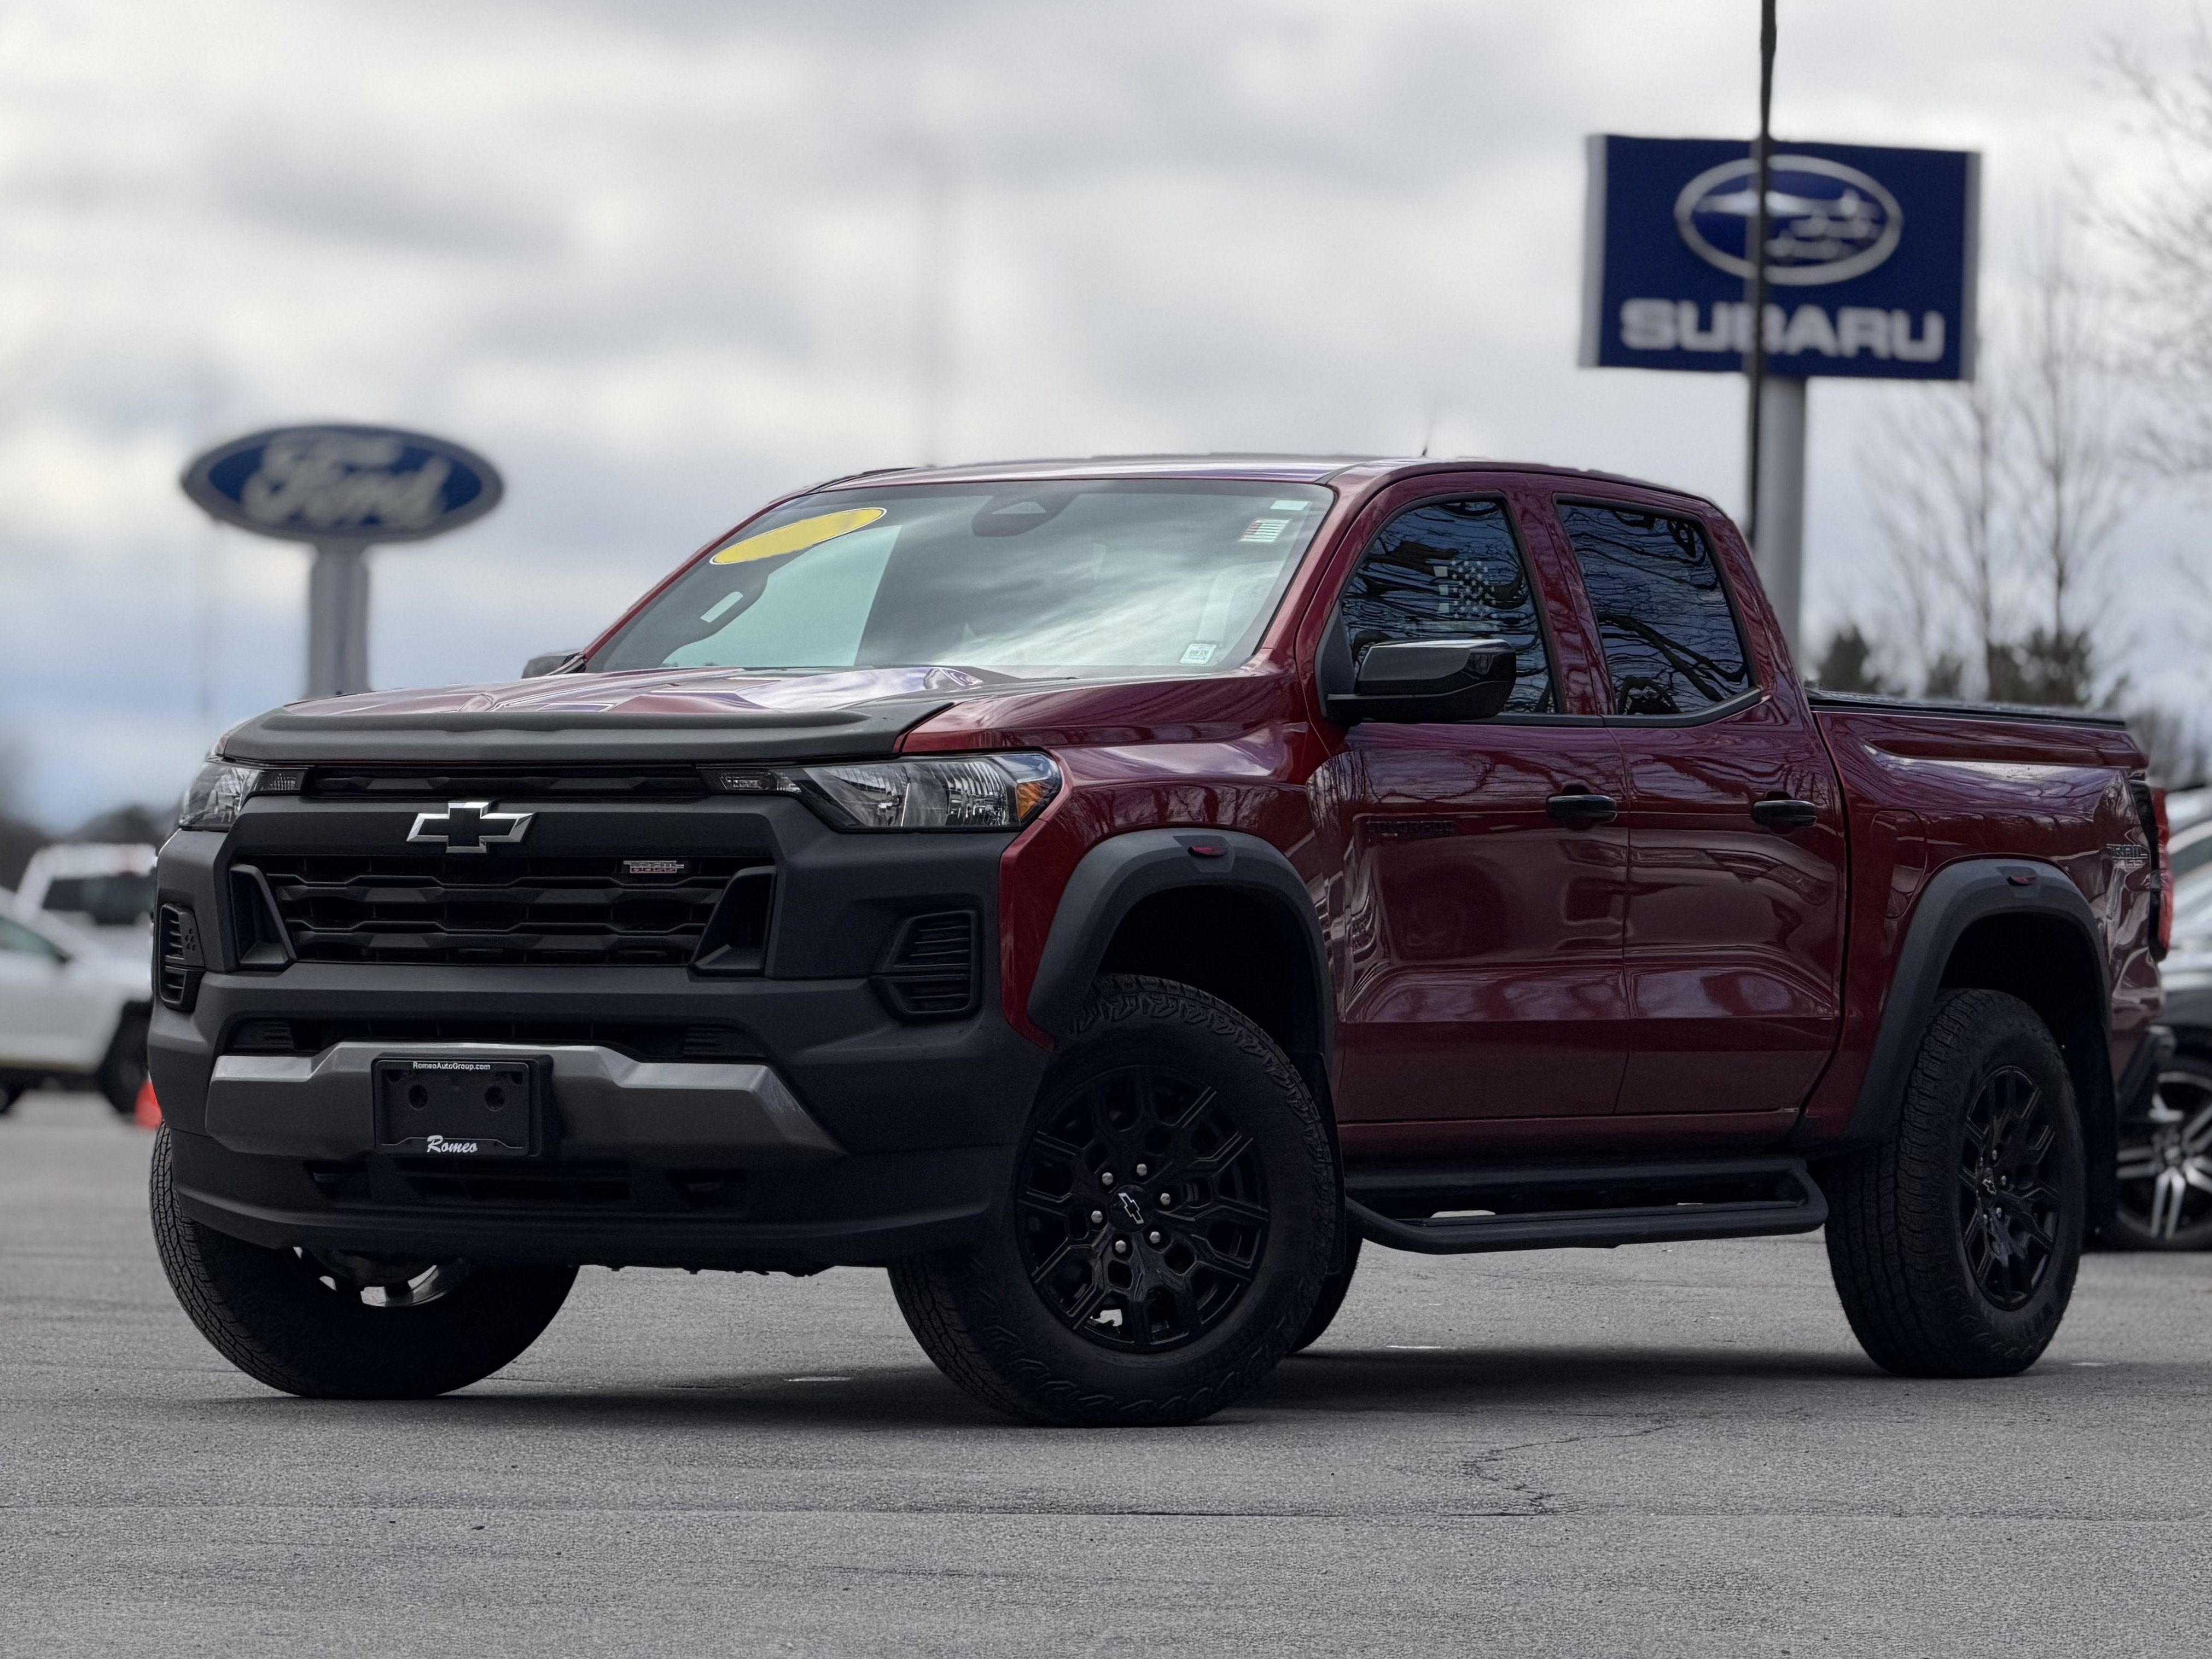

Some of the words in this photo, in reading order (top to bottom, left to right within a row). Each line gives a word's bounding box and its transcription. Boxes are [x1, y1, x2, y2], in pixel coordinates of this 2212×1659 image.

[1621, 299, 1945, 362] SUBARU
[412, 1062, 491, 1071] RomeoAutoGroup.com
[427, 1134, 478, 1153] Romeo
